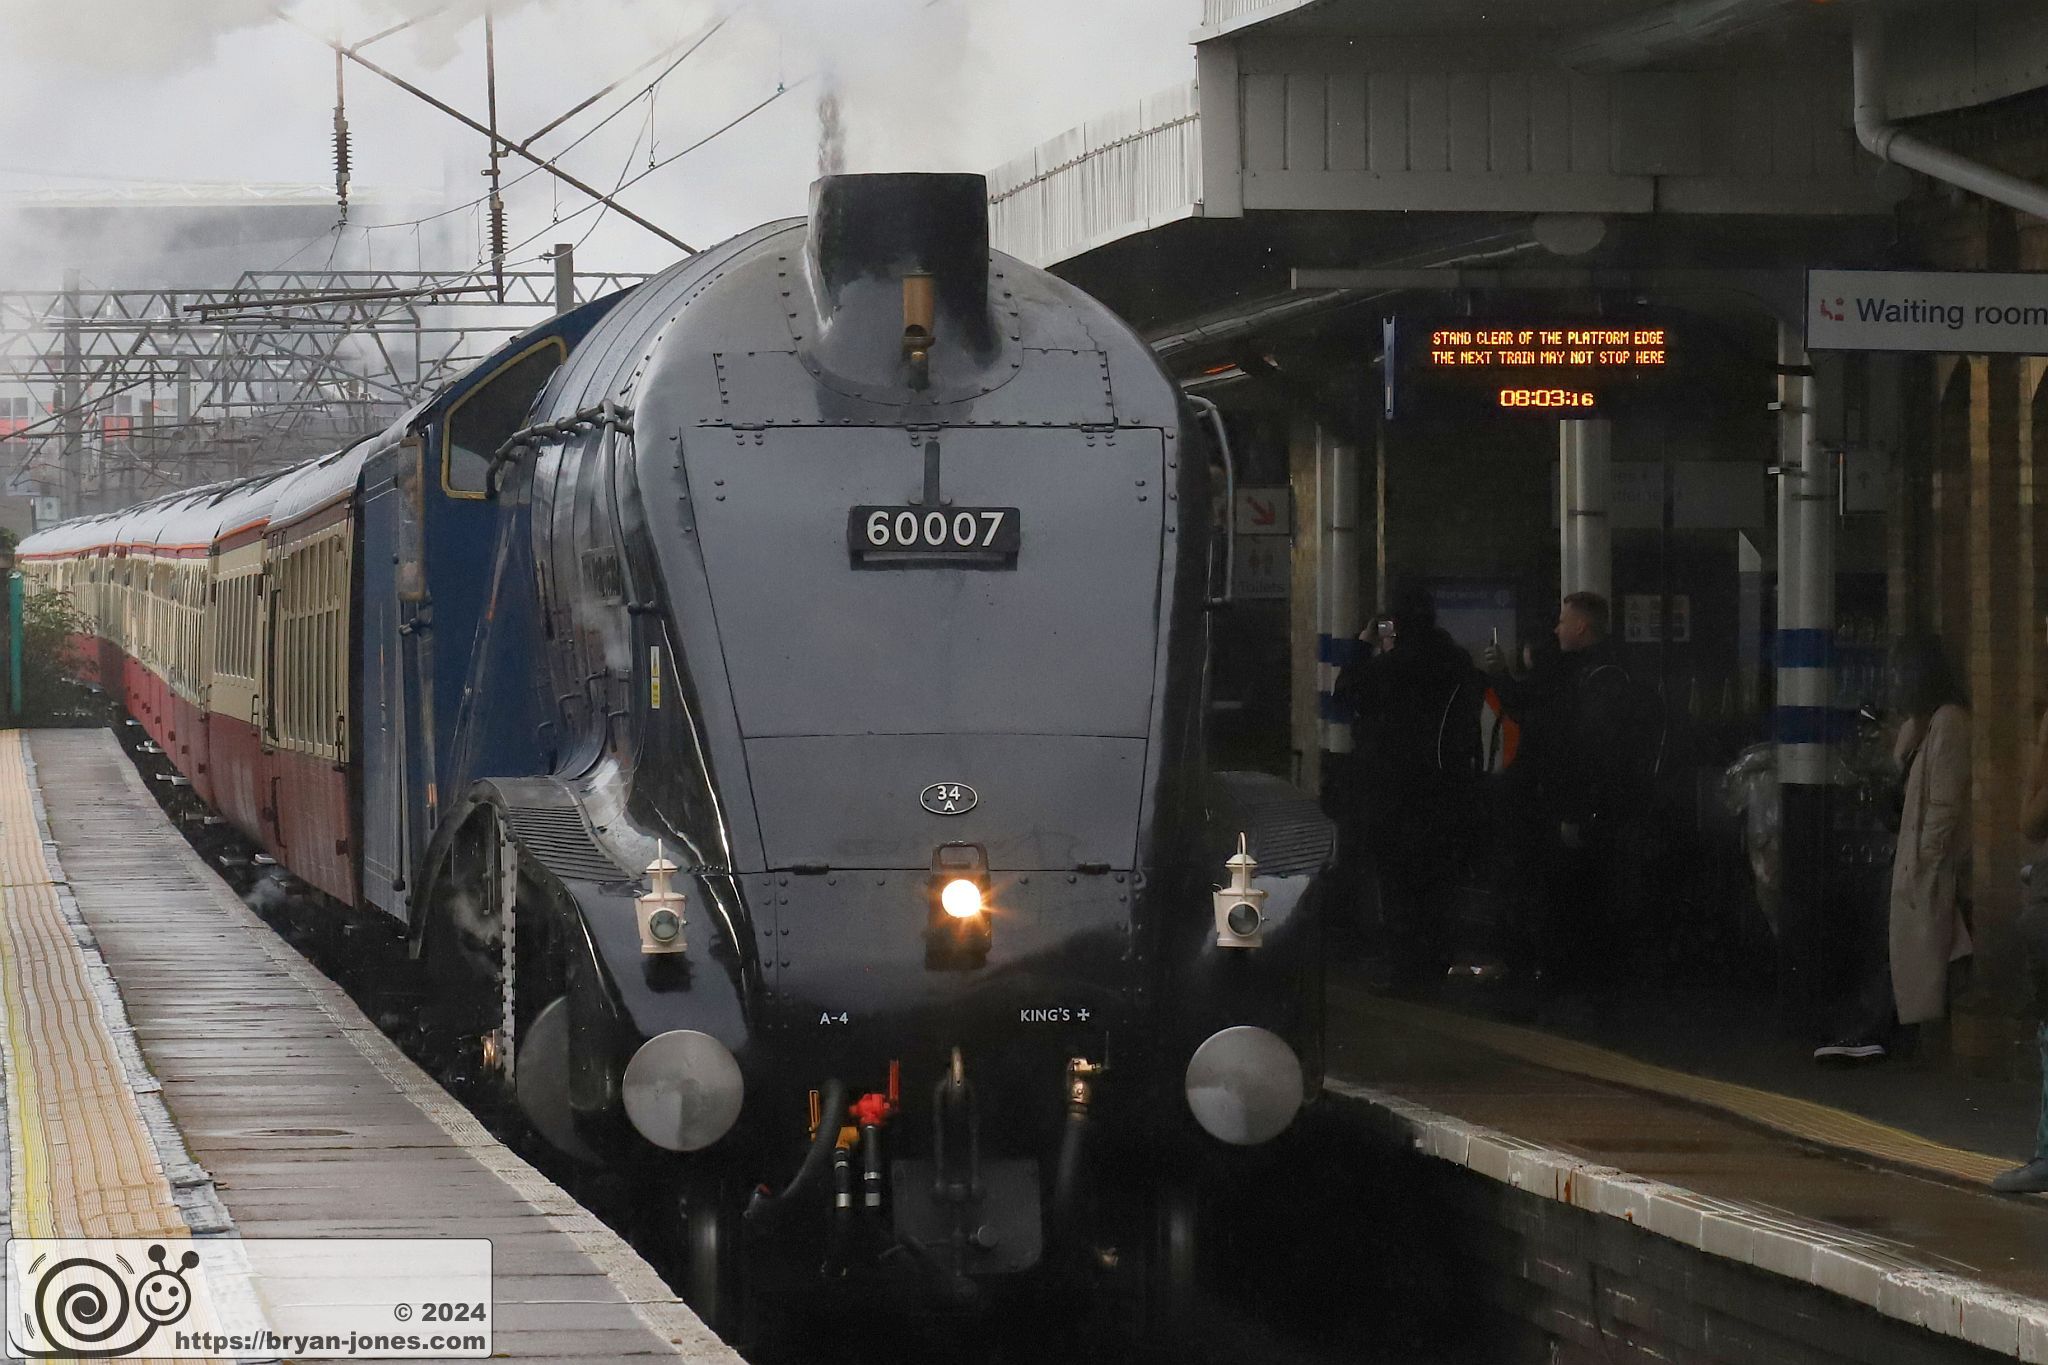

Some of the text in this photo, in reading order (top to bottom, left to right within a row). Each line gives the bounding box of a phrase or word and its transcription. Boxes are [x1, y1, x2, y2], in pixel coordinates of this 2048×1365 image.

[1856, 298, 2048, 329] Waiting room
[1433, 331, 1664, 345] STAND CLEAR OF THE PLATFORM EDGE
[1432, 350, 1665, 364] THE NEXT TRAIN MAY NOT STOP HERE
[1500, 389, 1594, 407] 08:03:16
[866, 510, 1005, 546] 60007
[937, 785, 961, 801] 34
[943, 800, 955, 811] A
[820, 1012, 849, 1025] A-4
[1020, 1008, 1070, 1022] KING'S
